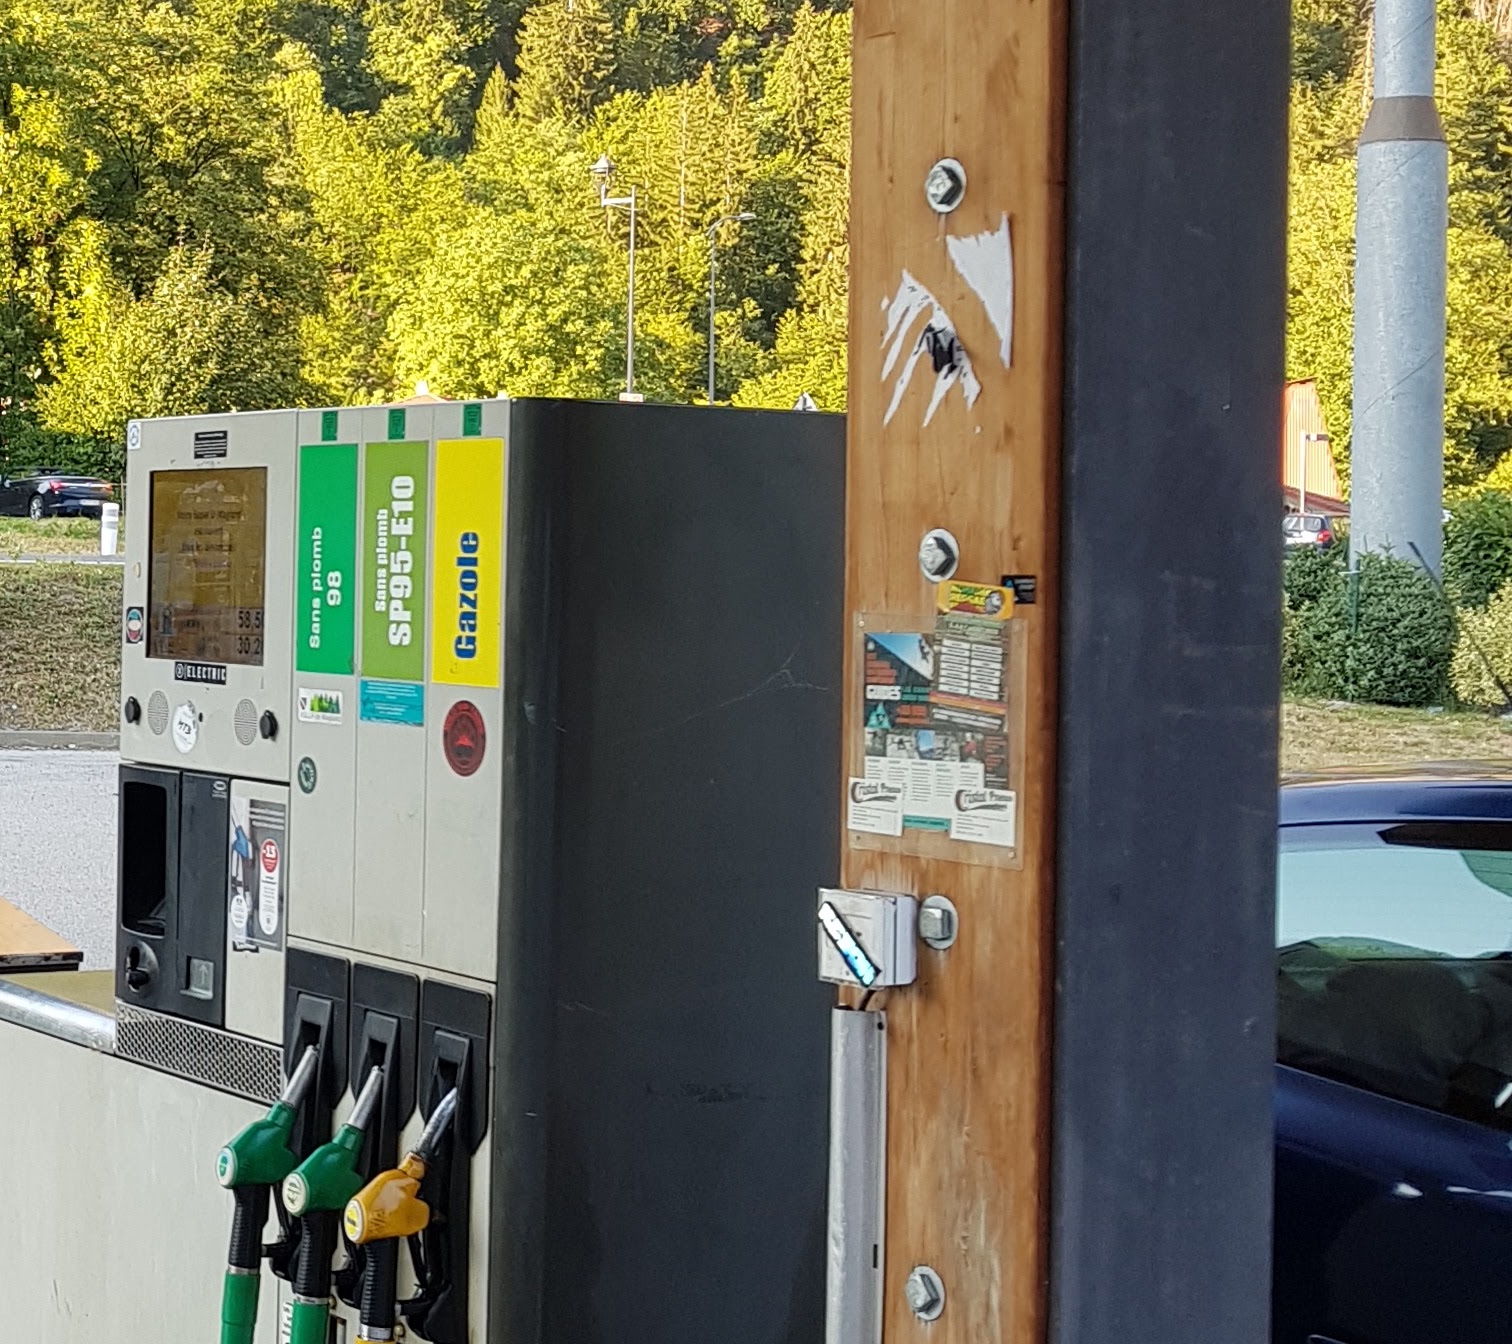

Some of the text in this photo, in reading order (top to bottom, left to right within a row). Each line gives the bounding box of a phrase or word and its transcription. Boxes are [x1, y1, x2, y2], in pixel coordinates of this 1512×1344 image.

[309, 527, 323, 649] Sans plomb
[326, 570, 342, 606] 98
[375, 509, 388, 612] Sans plomb
[388, 475, 414, 646] SP95-E10
[454, 532, 479, 659] Gazole
[186, 664, 226, 681] ELECTRIC
